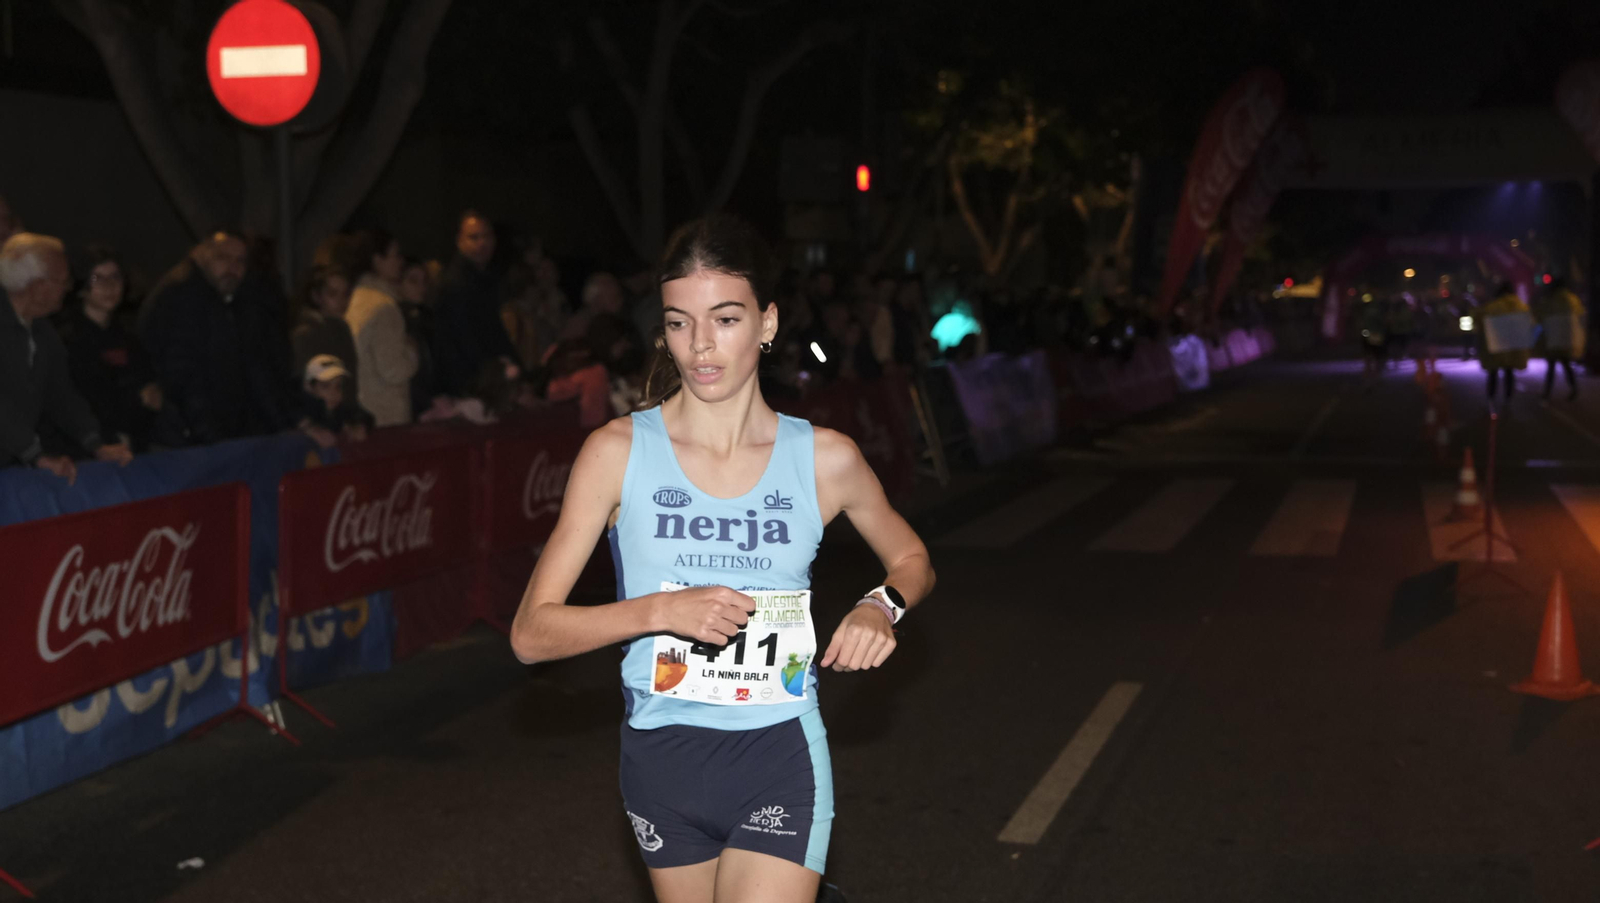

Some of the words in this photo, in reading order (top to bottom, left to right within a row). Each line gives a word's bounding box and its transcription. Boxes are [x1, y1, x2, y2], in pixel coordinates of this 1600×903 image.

[654, 490, 691, 506] TROPS
[764, 489, 794, 510] als
[653, 510, 792, 552] nerja
[674, 553, 773, 571] ATLETISMO
[37, 522, 202, 663] Coca-Cola
[748, 610, 761, 622] E
[690, 631, 779, 667] 411
[702, 668, 715, 679] LA
[717, 668, 741, 681] NIÑA
[743, 671, 769, 682] BALA
